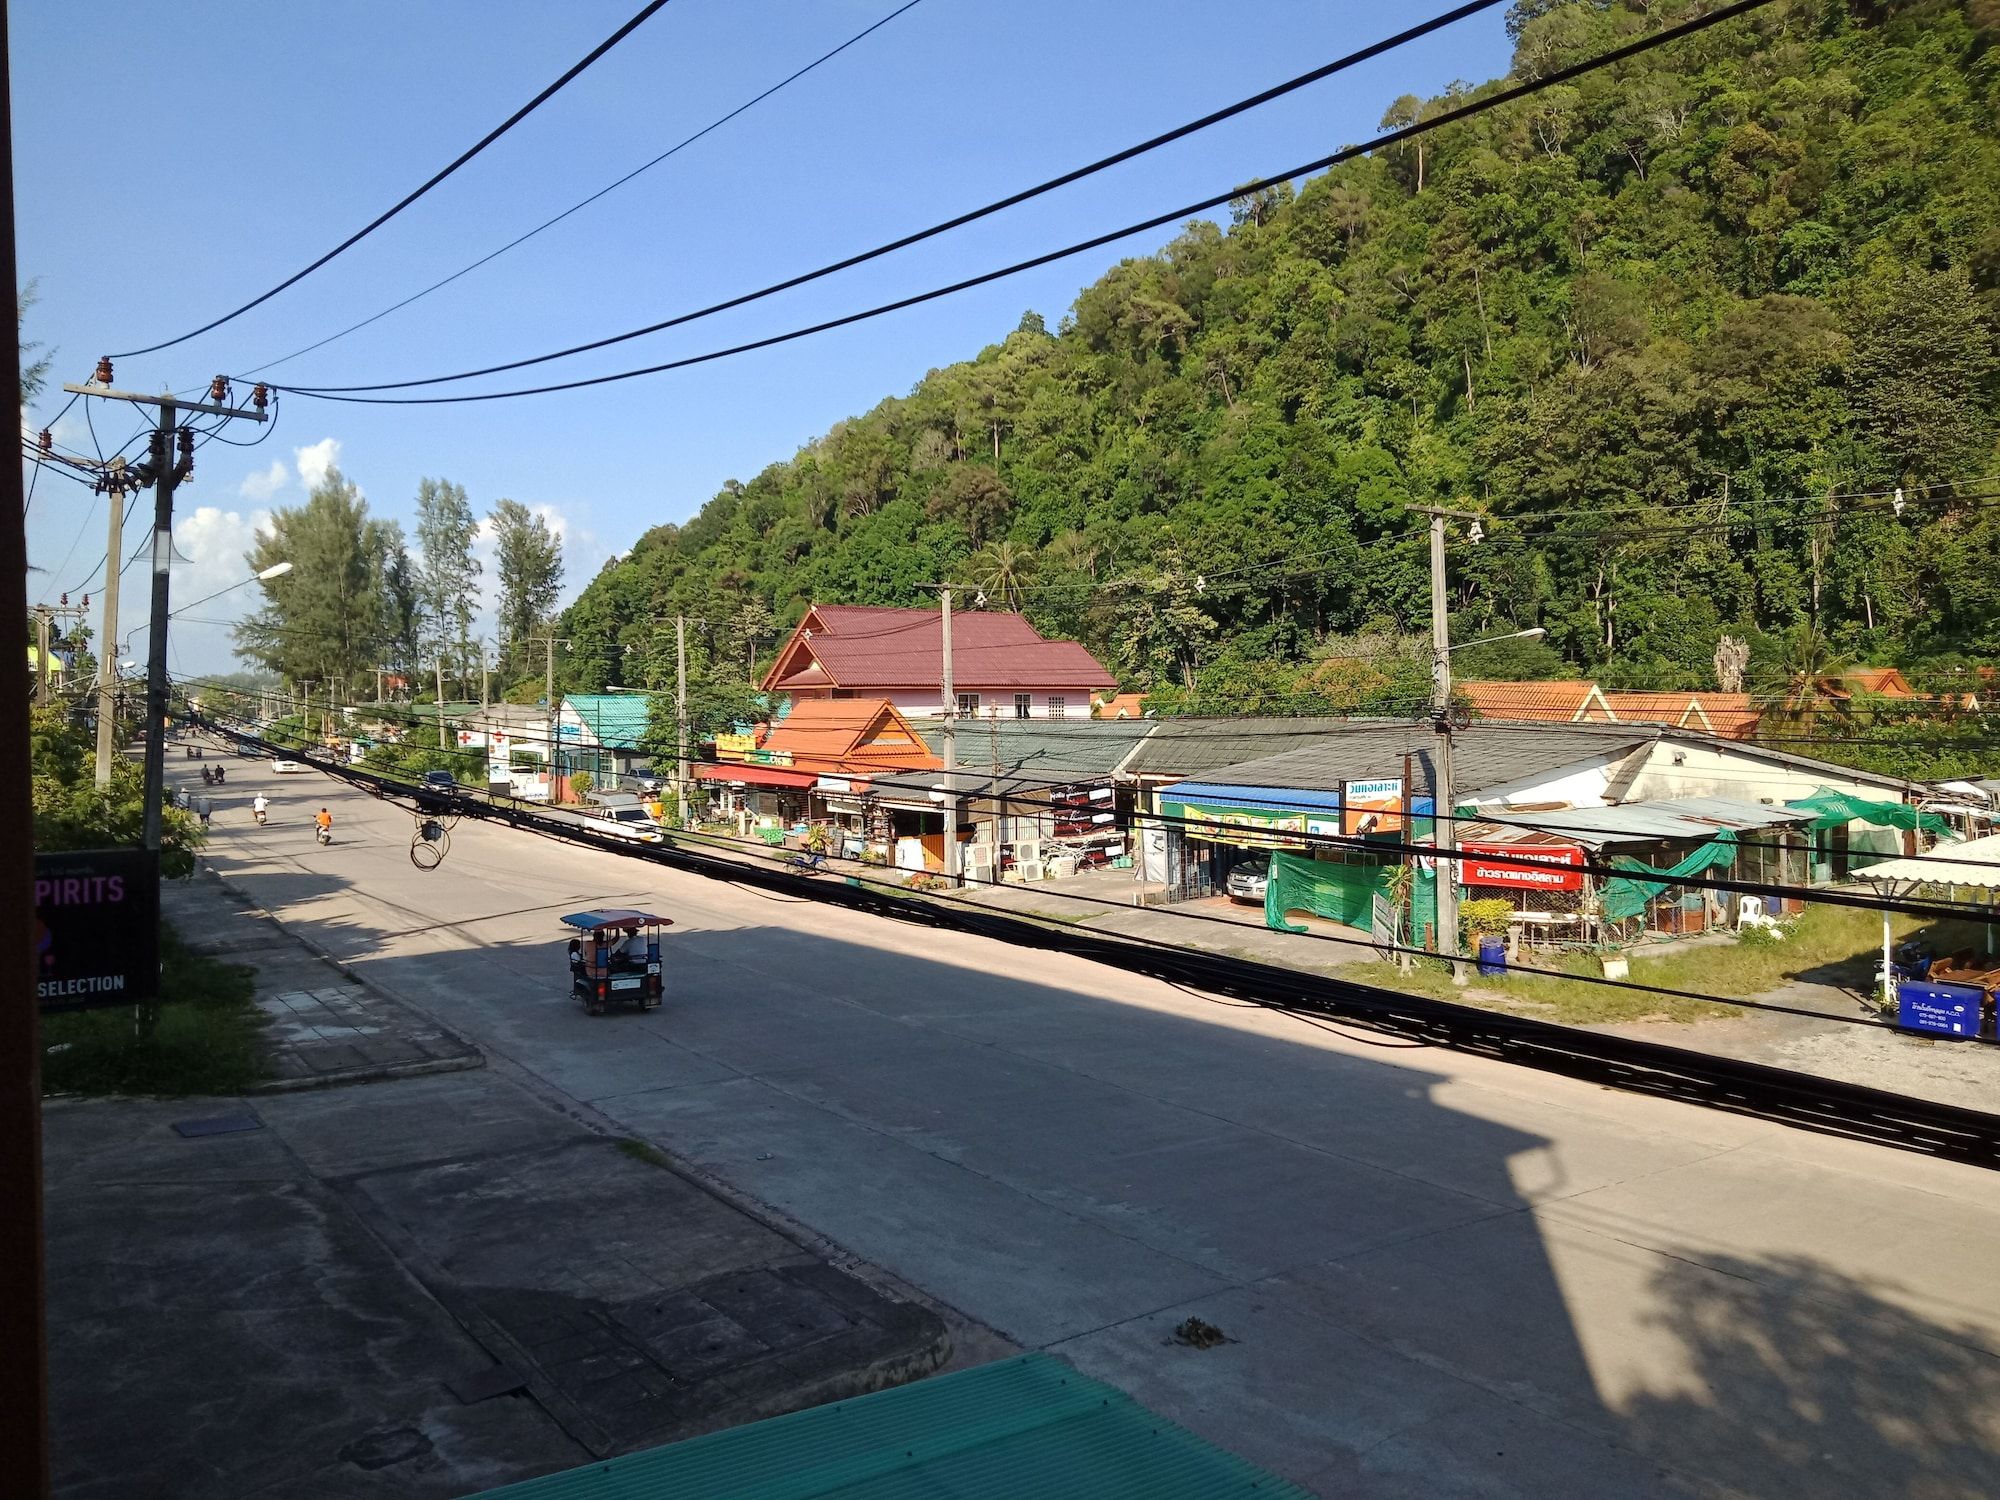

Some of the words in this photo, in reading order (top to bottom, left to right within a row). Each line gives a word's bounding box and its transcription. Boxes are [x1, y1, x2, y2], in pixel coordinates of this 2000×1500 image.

[1476, 866, 1565, 884] ข้าวราดแกงอิสลาม
[34, 875, 125, 907] PIRITS
[37, 975, 125, 998] SELECTION
